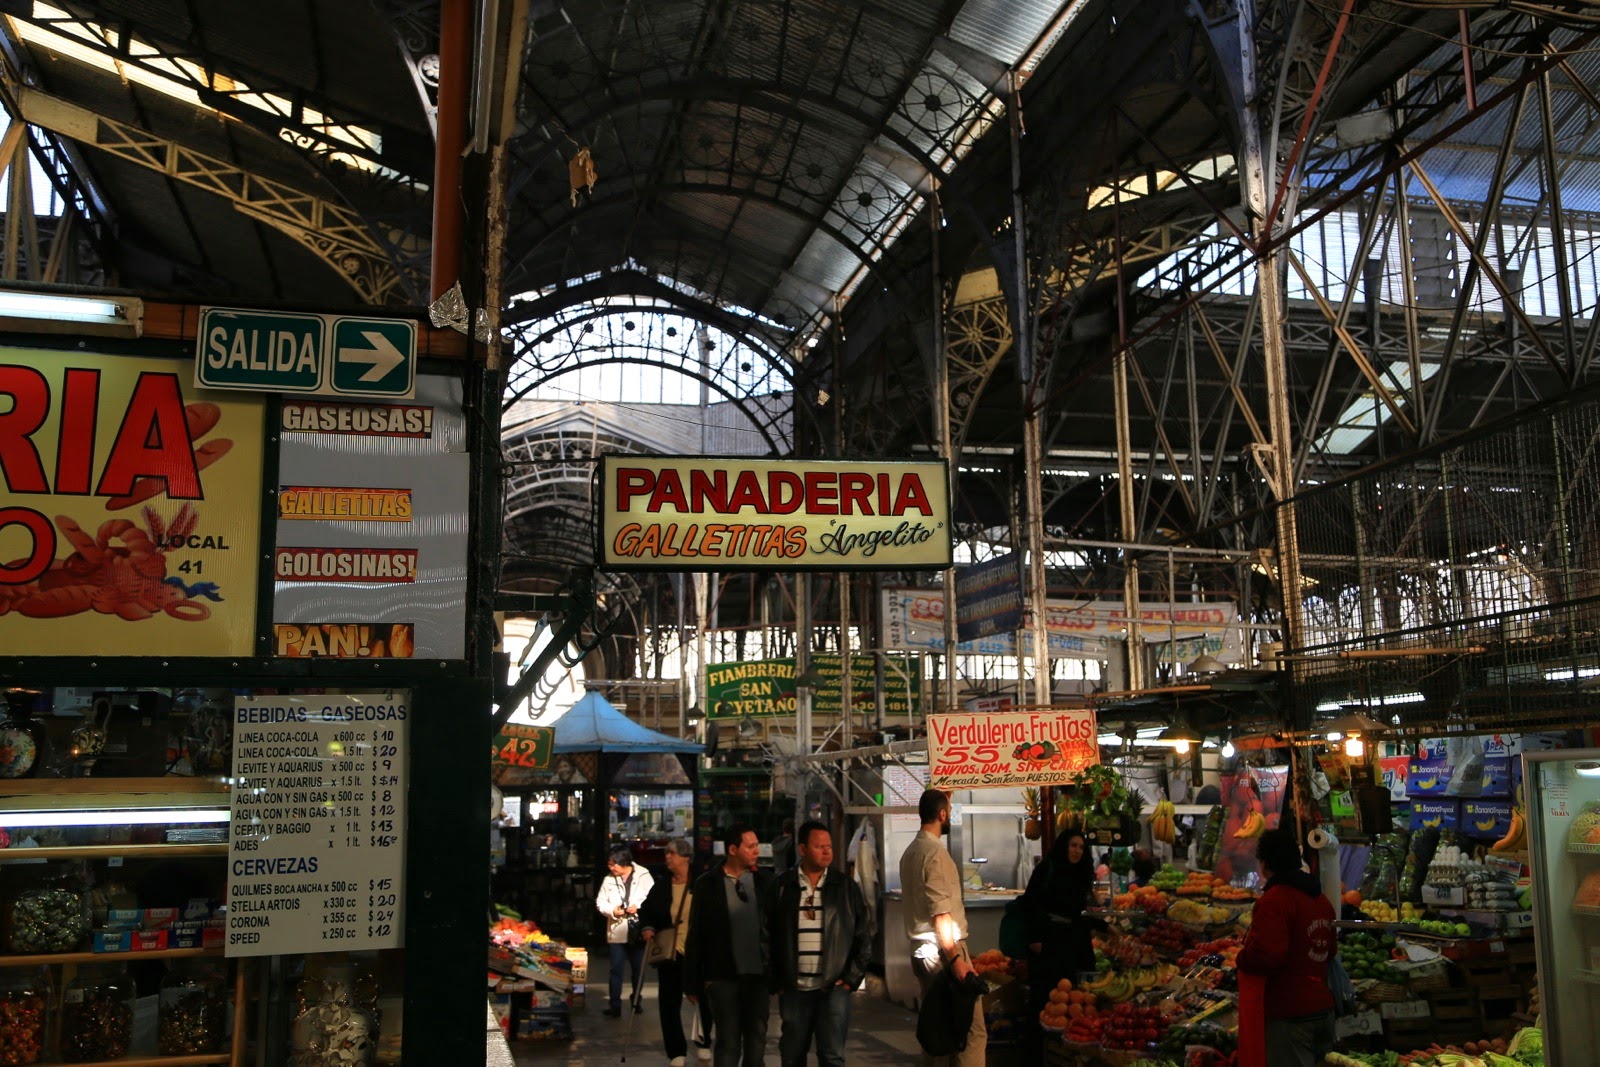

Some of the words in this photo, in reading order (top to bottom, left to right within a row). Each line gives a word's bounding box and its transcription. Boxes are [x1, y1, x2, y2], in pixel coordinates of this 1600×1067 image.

[207, 325, 317, 374] SALIDA
[282, 407, 433, 434] GASEOSAS!
[616, 467, 934, 517] PANADERIA
[280, 490, 412, 519] GALLETITAS
[157, 534, 230, 551] LOCAL
[612, 522, 808, 559] GALLETITAS
[178, 559, 203, 575] 41
[276, 552, 416, 578] GOLOSINAS!
[276, 624, 370, 658] PAN!
[740, 681, 772, 697] SAN
[237, 707, 307, 723] BEBIDAS
[321, 705, 407, 721] GASEOSAS
[238, 732, 264, 743] LINEA
[266, 732, 318, 743] COCA-COLA
[373, 730, 378, 742] $
[238, 748, 264, 758] LINEA
[266, 746, 318, 758] COCA-COLA
[372, 746, 377, 756] $
[380, 745, 397, 757] 20
[499, 737, 538, 768] 42
[238, 763, 268, 774] LEVITE
[269, 762, 276, 774] Y
[277, 761, 323, 774] AQUARIUS
[339, 762, 354, 772] 500
[355, 763, 364, 771] cc
[372, 760, 377, 772] $
[382, 760, 392, 770] 9
[933, 764, 976, 776] ENVIOS
[981, 762, 1011, 774] DOM.
[1016, 762, 1042, 773] SIN
[236, 778, 268, 790] LEVITE
[269, 778, 276, 788] Y
[277, 776, 322, 788] AQUARIUS
[341, 776, 352, 786] 1.5
[934, 775, 980, 786] Mercado
[1026, 772, 1066, 783] PUESTOS
[236, 794, 260, 804] AGUA
[264, 792, 284, 804] CON
[284, 792, 291, 804] Y
[292, 792, 306, 804] SIN
[309, 792, 328, 803] GAS
[338, 792, 352, 802] 500
[372, 790, 376, 802] $
[382, 790, 392, 802] 8
[235, 809, 261, 820] AGUA
[262, 808, 282, 820] CON
[284, 808, 291, 818] Y
[292, 807, 306, 818] SIN
[309, 806, 328, 818] GAS
[340, 807, 352, 817] 1.5
[371, 805, 376, 816] $
[379, 805, 395, 816] 12
[234, 824, 266, 836] CEPITA
[268, 824, 274, 834] Y
[276, 822, 311, 834] BAGGIO
[370, 821, 376, 832] $
[378, 820, 393, 832] 13
[234, 840, 259, 851] ADES
[232, 856, 318, 876] CERVEZAS
[232, 884, 272, 896] QUILMES
[274, 884, 296, 894] BOCA
[297, 883, 322, 894] ANCHA
[331, 881, 346, 892] 500
[348, 882, 358, 891] cc
[369, 880, 374, 891] $
[377, 878, 392, 890] 15
[231, 900, 266, 912] STELLA
[267, 898, 300, 910] ARTOIS
[330, 898, 344, 908] 330
[346, 899, 356, 908] cc
[368, 895, 374, 907] $
[378, 894, 396, 907] 20
[230, 916, 270, 928] CORONA
[330, 912, 345, 923] 355
[346, 914, 356, 922] cc
[368, 910, 374, 922] $
[376, 910, 394, 922] 24
[230, 932, 260, 945] SPEED
[330, 928, 344, 938] 250
[346, 930, 356, 938] cc
[368, 926, 373, 938] $
[375, 924, 392, 936] 12
